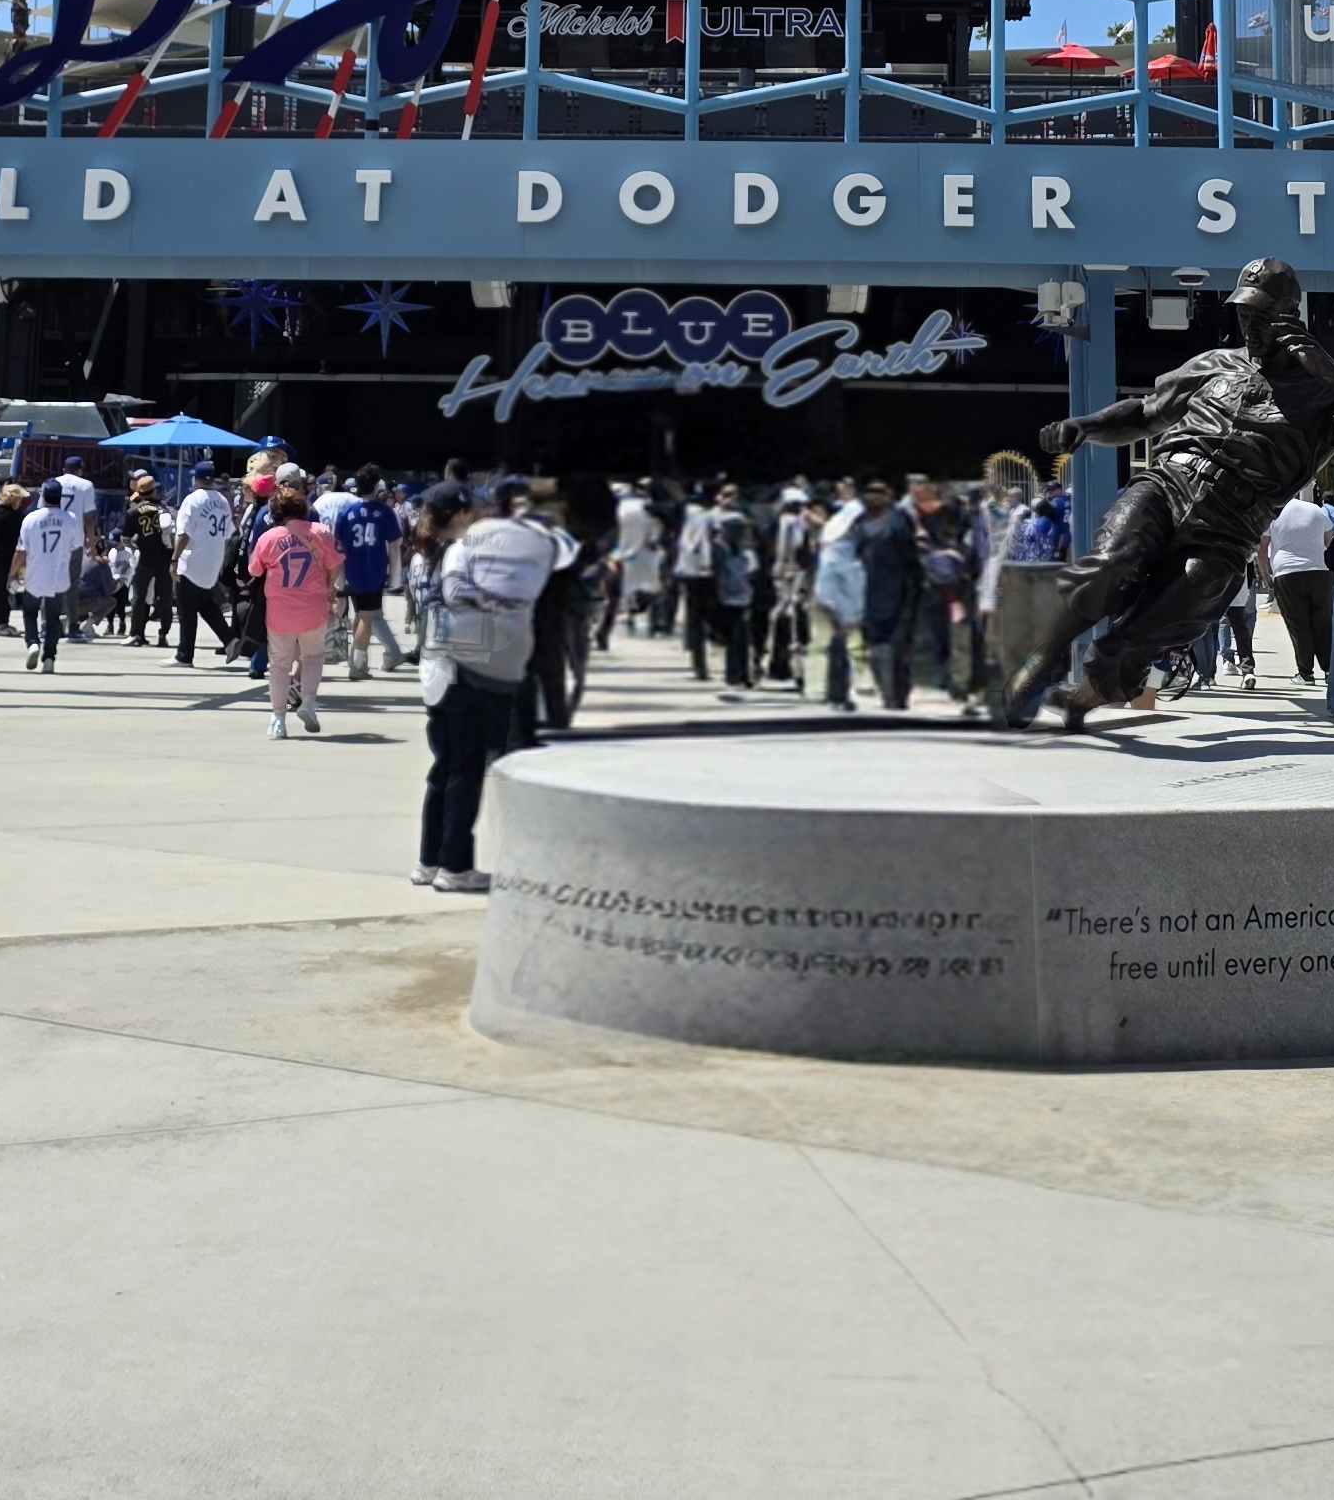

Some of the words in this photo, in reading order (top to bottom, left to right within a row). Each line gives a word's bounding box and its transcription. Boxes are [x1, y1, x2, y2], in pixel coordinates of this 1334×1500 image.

[507, 1, 656, 38] Michelob
[698, 7, 845, 37] ULTRA
[253, 169, 393, 222] AT
[517, 170, 1076, 229] DODGER
[561, 309, 775, 345] BLUE
[761, 309, 988, 407] Earth
[41, 530, 62, 553] 17
[208, 514, 229, 537] 34
[351, 521, 376, 548] 34
[279, 552, 312, 588] 17
[1159, 912, 1199, 933] not
[1206, 911, 1236, 932] an
[1109, 951, 1158, 981] free
[1168, 948, 1215, 978] until
[1224, 952, 1291, 982] every
